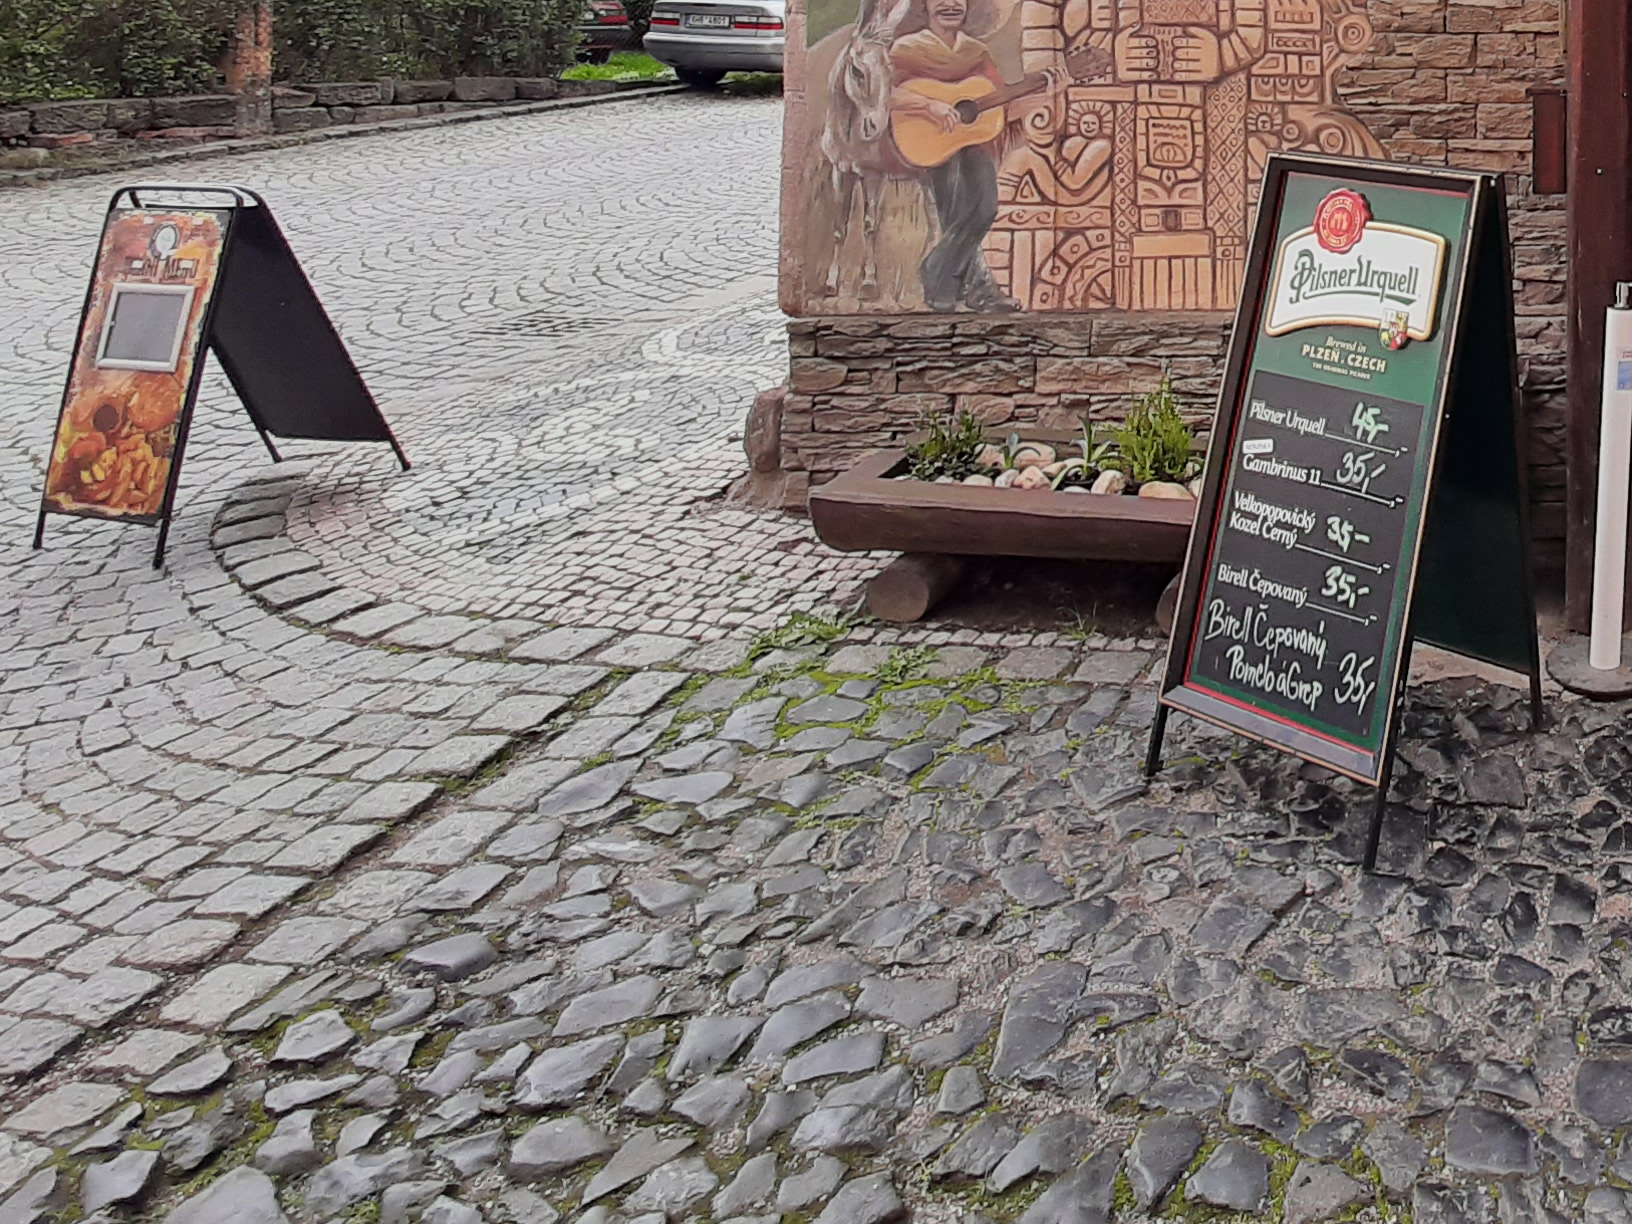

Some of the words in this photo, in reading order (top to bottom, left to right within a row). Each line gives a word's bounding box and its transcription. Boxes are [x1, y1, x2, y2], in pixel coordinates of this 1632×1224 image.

[1289, 248, 1357, 305] Pilsner
[1356, 254, 1420, 304] Urquell
[1325, 335, 1358, 351] Brewed
[1357, 340, 1367, 353] in
[1347, 353, 1387, 373] CZECH
[1248, 401, 1286, 425] Pilsner
[1286, 408, 1326, 436] Urquell
[1242, 453, 1309, 483] Gambrinus
[1309, 468, 1321, 486] 11
[1229, 511, 1262, 535] Kozel
[1262, 517, 1298, 550] Černý
[1233, 490, 1316, 534] Velkopopovický
[1217, 563, 1249, 588] Birell
[1249, 568, 1308, 609] Čepovaný
[1204, 598, 1253, 643] Birell
[1253, 603, 1328, 671] Čepovaný
[1225, 644, 1275, 694] Pomelo
